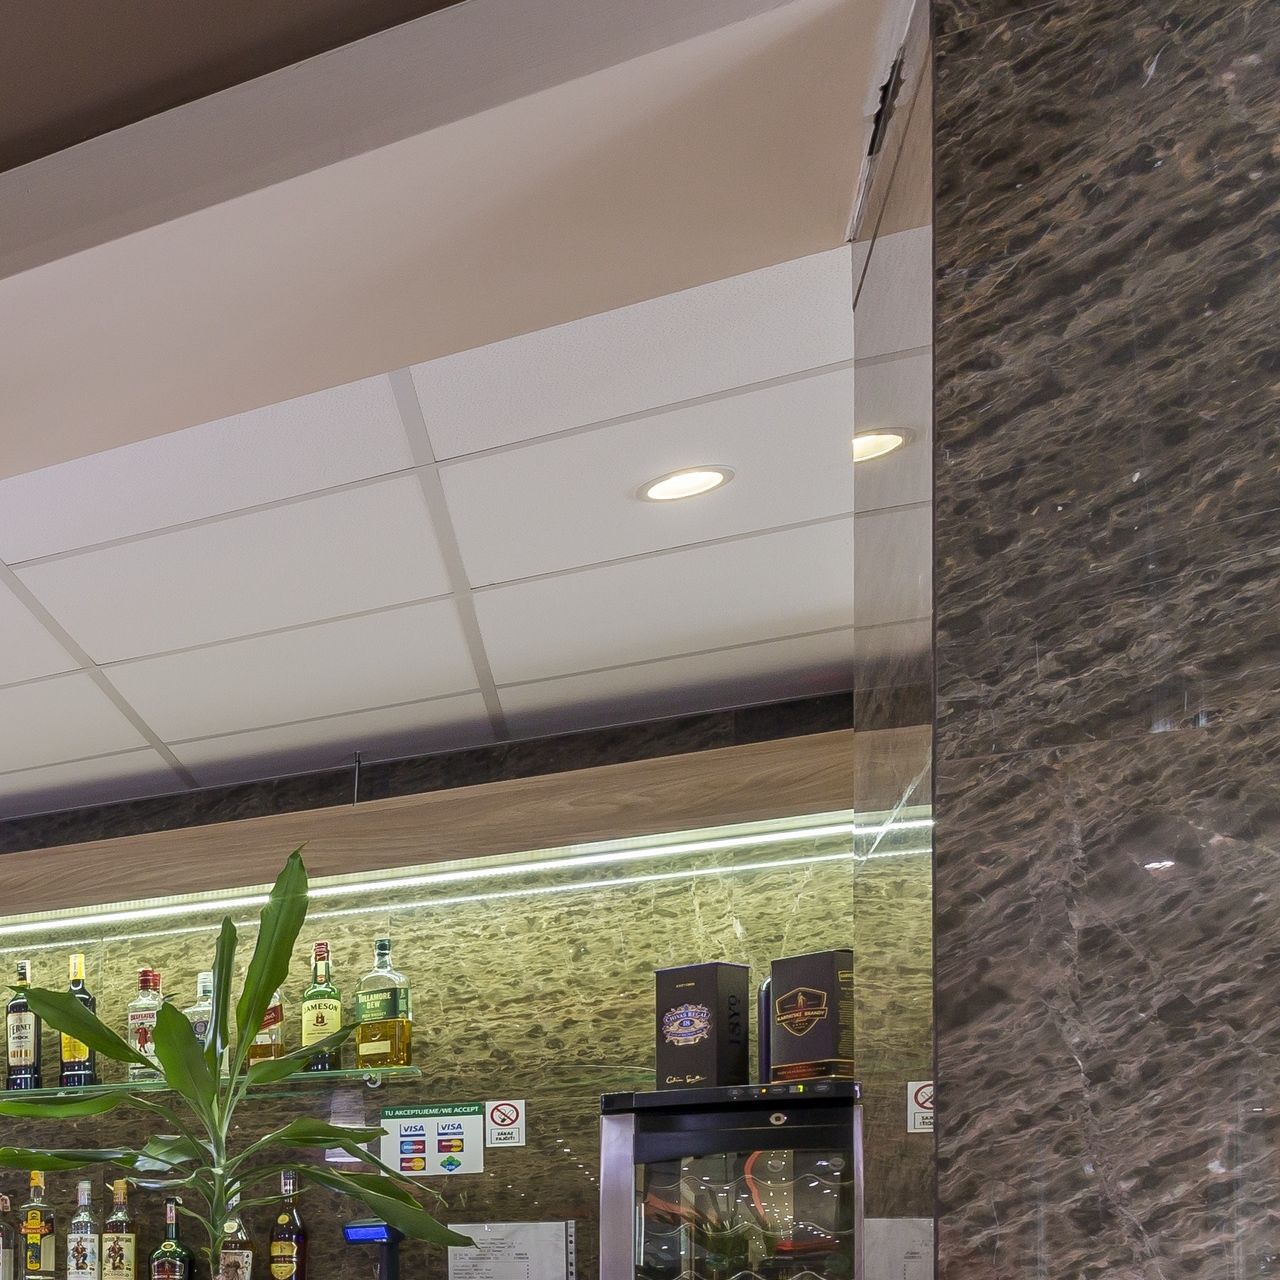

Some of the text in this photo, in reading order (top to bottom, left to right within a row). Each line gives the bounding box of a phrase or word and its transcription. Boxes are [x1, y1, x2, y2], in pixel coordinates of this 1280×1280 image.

[358, 991, 391, 1003] TULLAMORE
[304, 1002, 338, 1014] JAMESON
[130, 1013, 156, 1021] BEEFEATER
[666, 1013, 687, 1022] CHIVAS
[454, 1106, 480, 1114] ACCEPT
[403, 1124, 425, 1132] VISA
